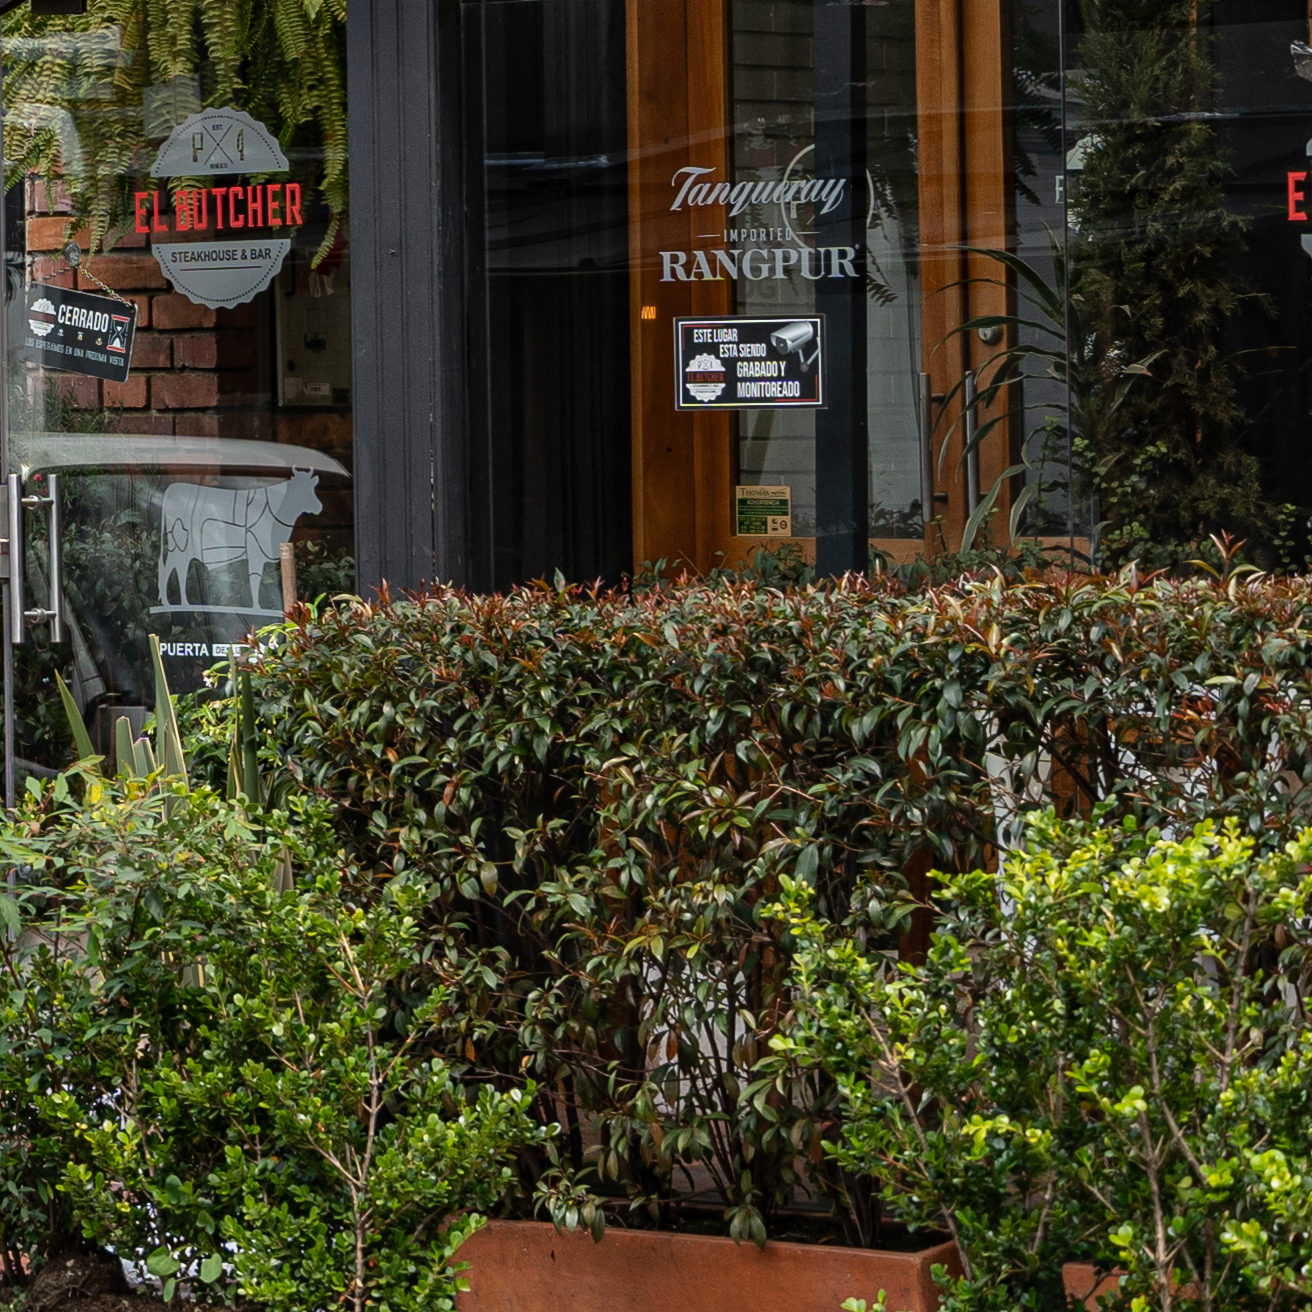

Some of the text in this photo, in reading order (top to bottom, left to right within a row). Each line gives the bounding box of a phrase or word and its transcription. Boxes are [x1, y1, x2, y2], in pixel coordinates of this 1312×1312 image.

[670, 166, 846, 217] Tanqueray
[134, 182, 303, 234] EL BUTCHER
[723, 227, 792, 243] IMPORTED
[170, 247, 272, 263] STEAKHOUSE & BAR
[659, 246, 860, 282] RANGPUR
[57, 304, 109, 333] CERRADO
[693, 328, 738, 343] ESTE LUGAR
[719, 343, 766, 358] ESTA SIENDO
[736, 360, 787, 378] GRABADO Y
[737, 381, 800, 398] MONITOREADO
[159, 642, 209, 657] PUERTA
